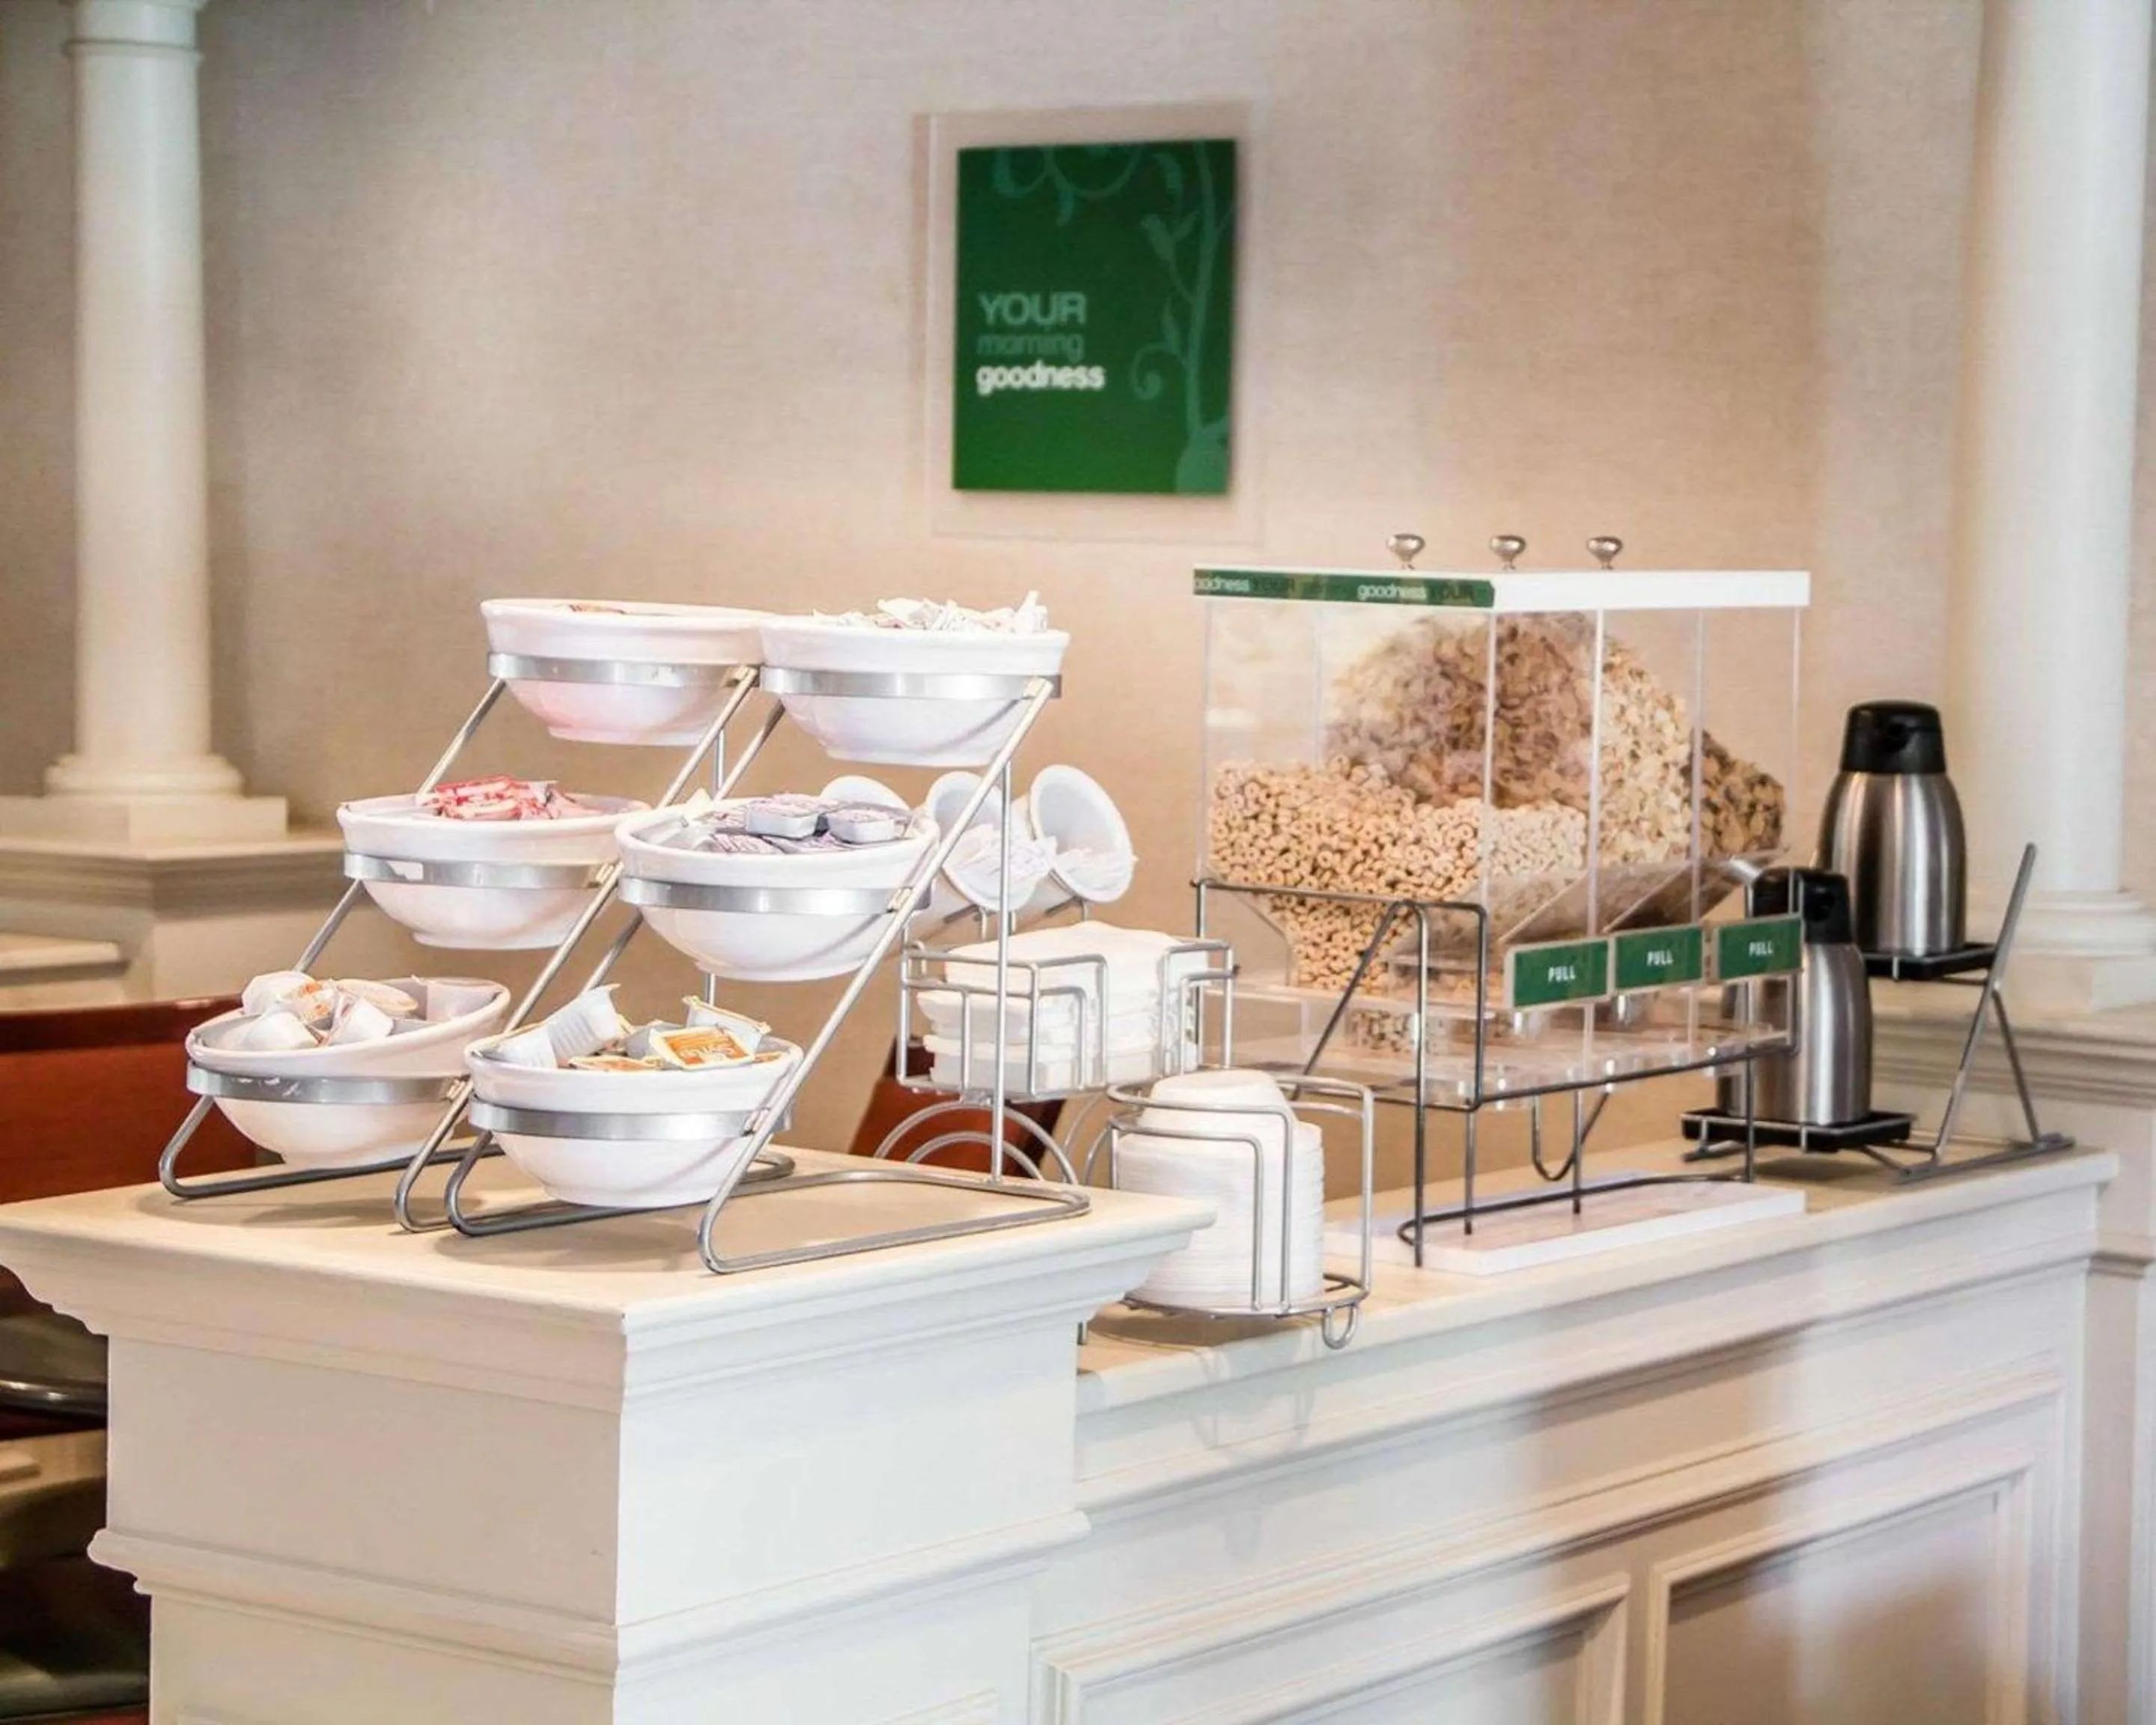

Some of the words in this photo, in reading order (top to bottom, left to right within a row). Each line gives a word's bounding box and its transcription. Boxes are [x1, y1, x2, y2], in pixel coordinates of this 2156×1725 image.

[977, 291, 1086, 325] YOUR
[976, 335, 1084, 364] morning
[975, 359, 1104, 395] goodness
[1194, 576, 1249, 592] oodness
[1357, 583, 1427, 602] goodness
[1647, 949, 1674, 966] PULL
[1749, 940, 1774, 957] PULL
[1548, 964, 1576, 982] PULL
